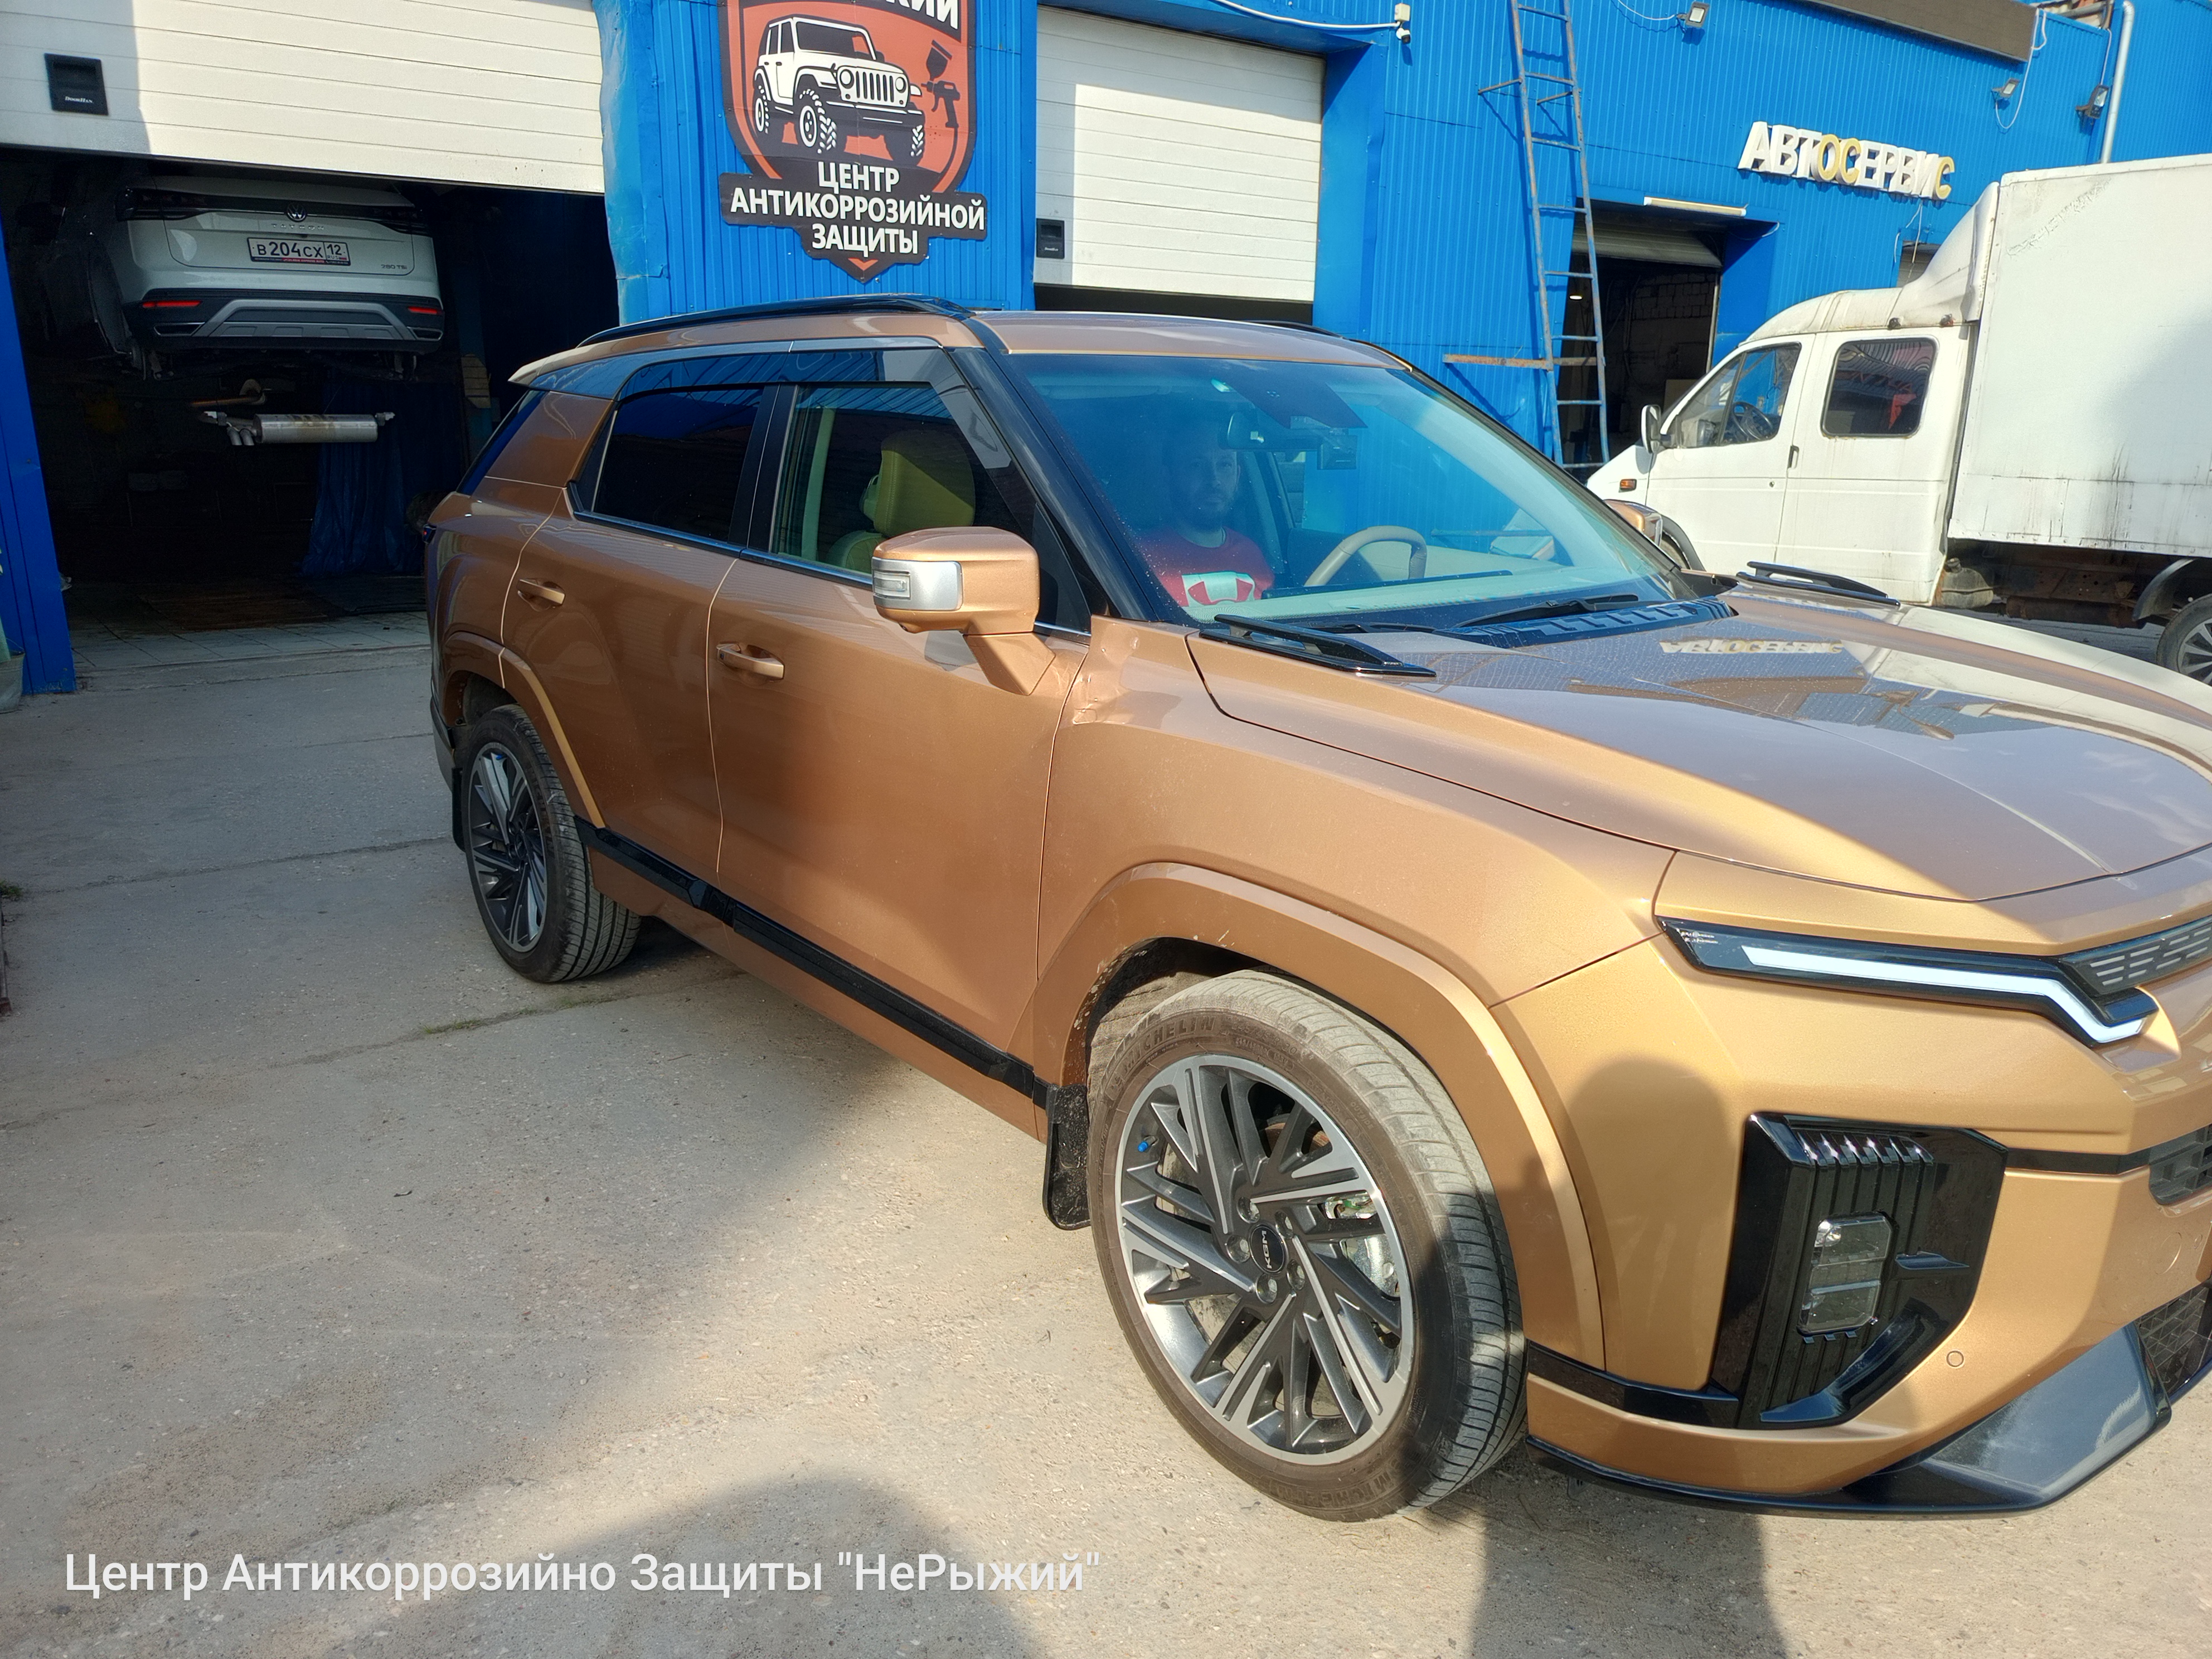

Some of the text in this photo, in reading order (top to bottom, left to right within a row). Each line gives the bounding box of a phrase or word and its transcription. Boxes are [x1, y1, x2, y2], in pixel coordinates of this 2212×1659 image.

[818, 161, 900, 193] ЦЕНТР
[1738, 121, 1955, 200] АВТОСЕРВИС
[730, 187, 984, 230] АНТИКОРРОЗИЙНОЙ
[327, 244, 342, 255] 12
[812, 224, 918, 258] ЗАЩИТЫ
[1124, 1016, 1216, 1073] MICHELIN
[1350, 1102, 1374, 1129] OUTSIDE
[1262, 1230, 1272, 1269] KGM
